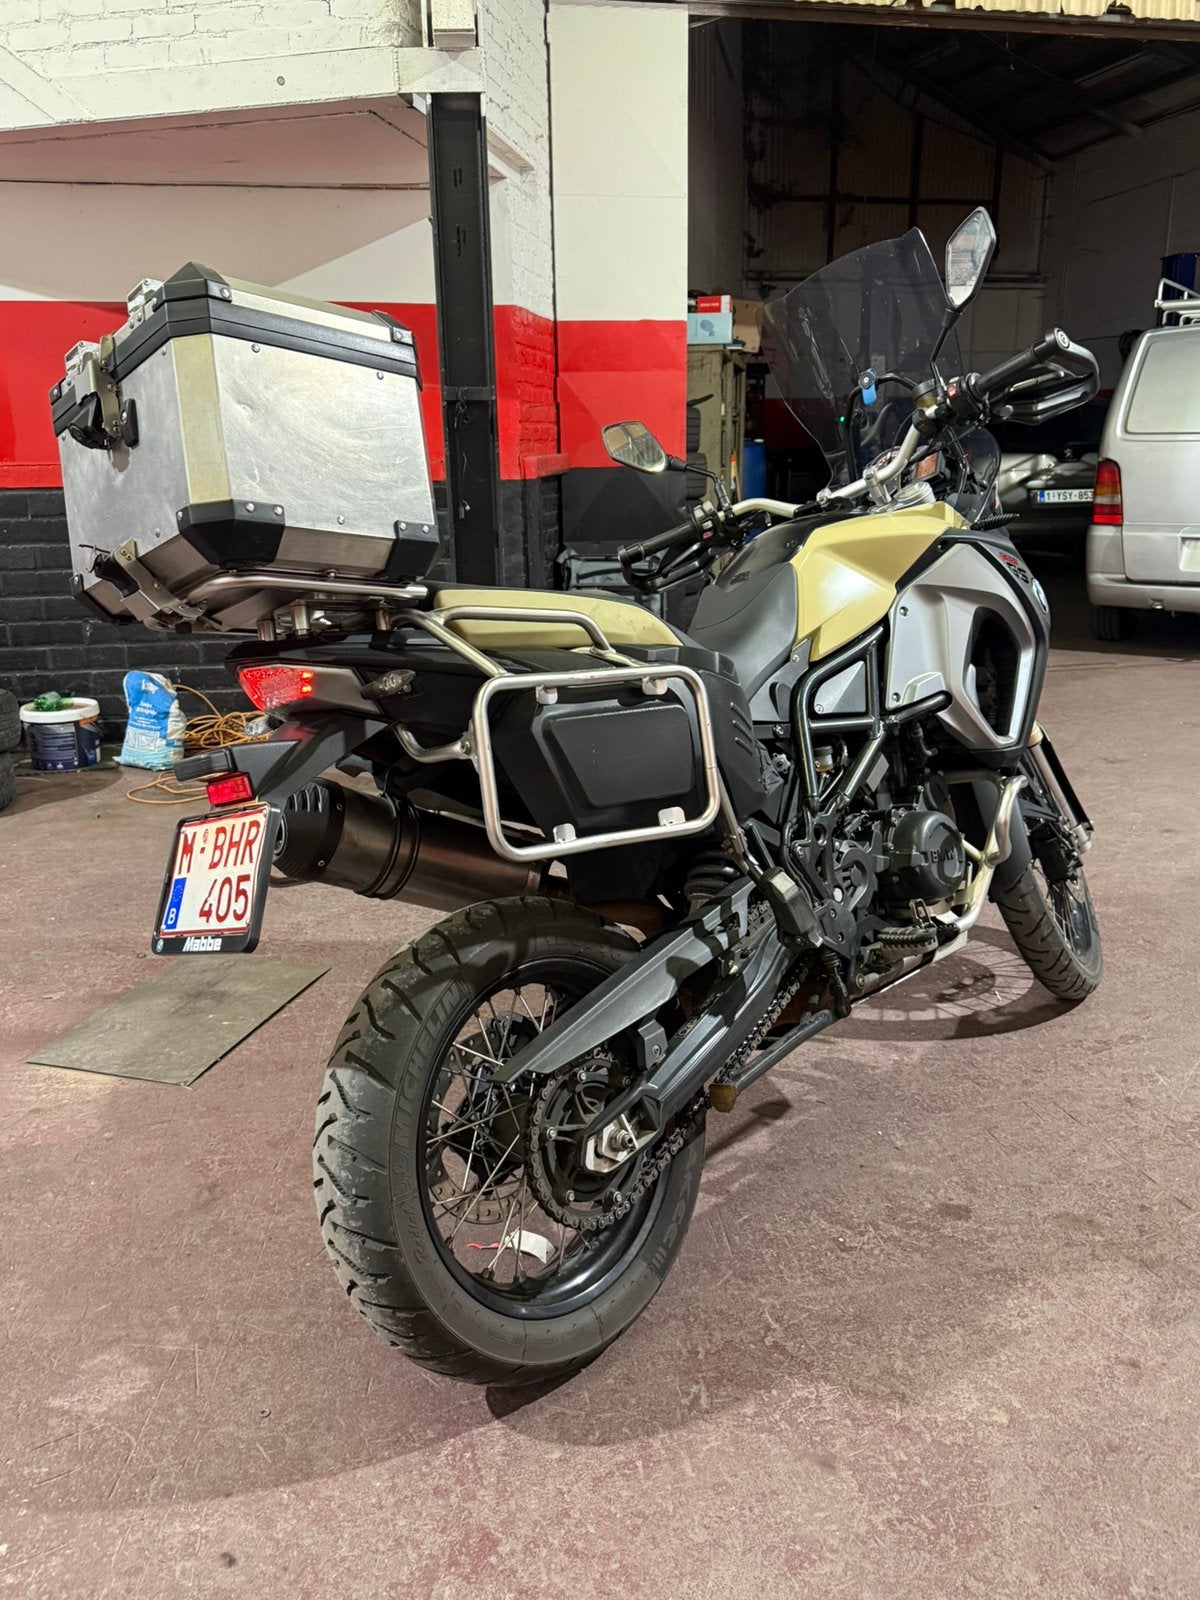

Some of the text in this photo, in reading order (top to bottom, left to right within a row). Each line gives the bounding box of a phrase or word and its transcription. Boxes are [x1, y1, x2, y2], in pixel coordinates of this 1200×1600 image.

[1046, 490, 1094, 502] 1-YSY-853
[178, 820, 261, 875] M-BHR
[930, 847, 954, 863] BMW
[199, 874, 251, 923] 405
[167, 908, 177, 925] B
[182, 937, 222, 952] Mabbe
[393, 979, 466, 1149] MICHELIN
